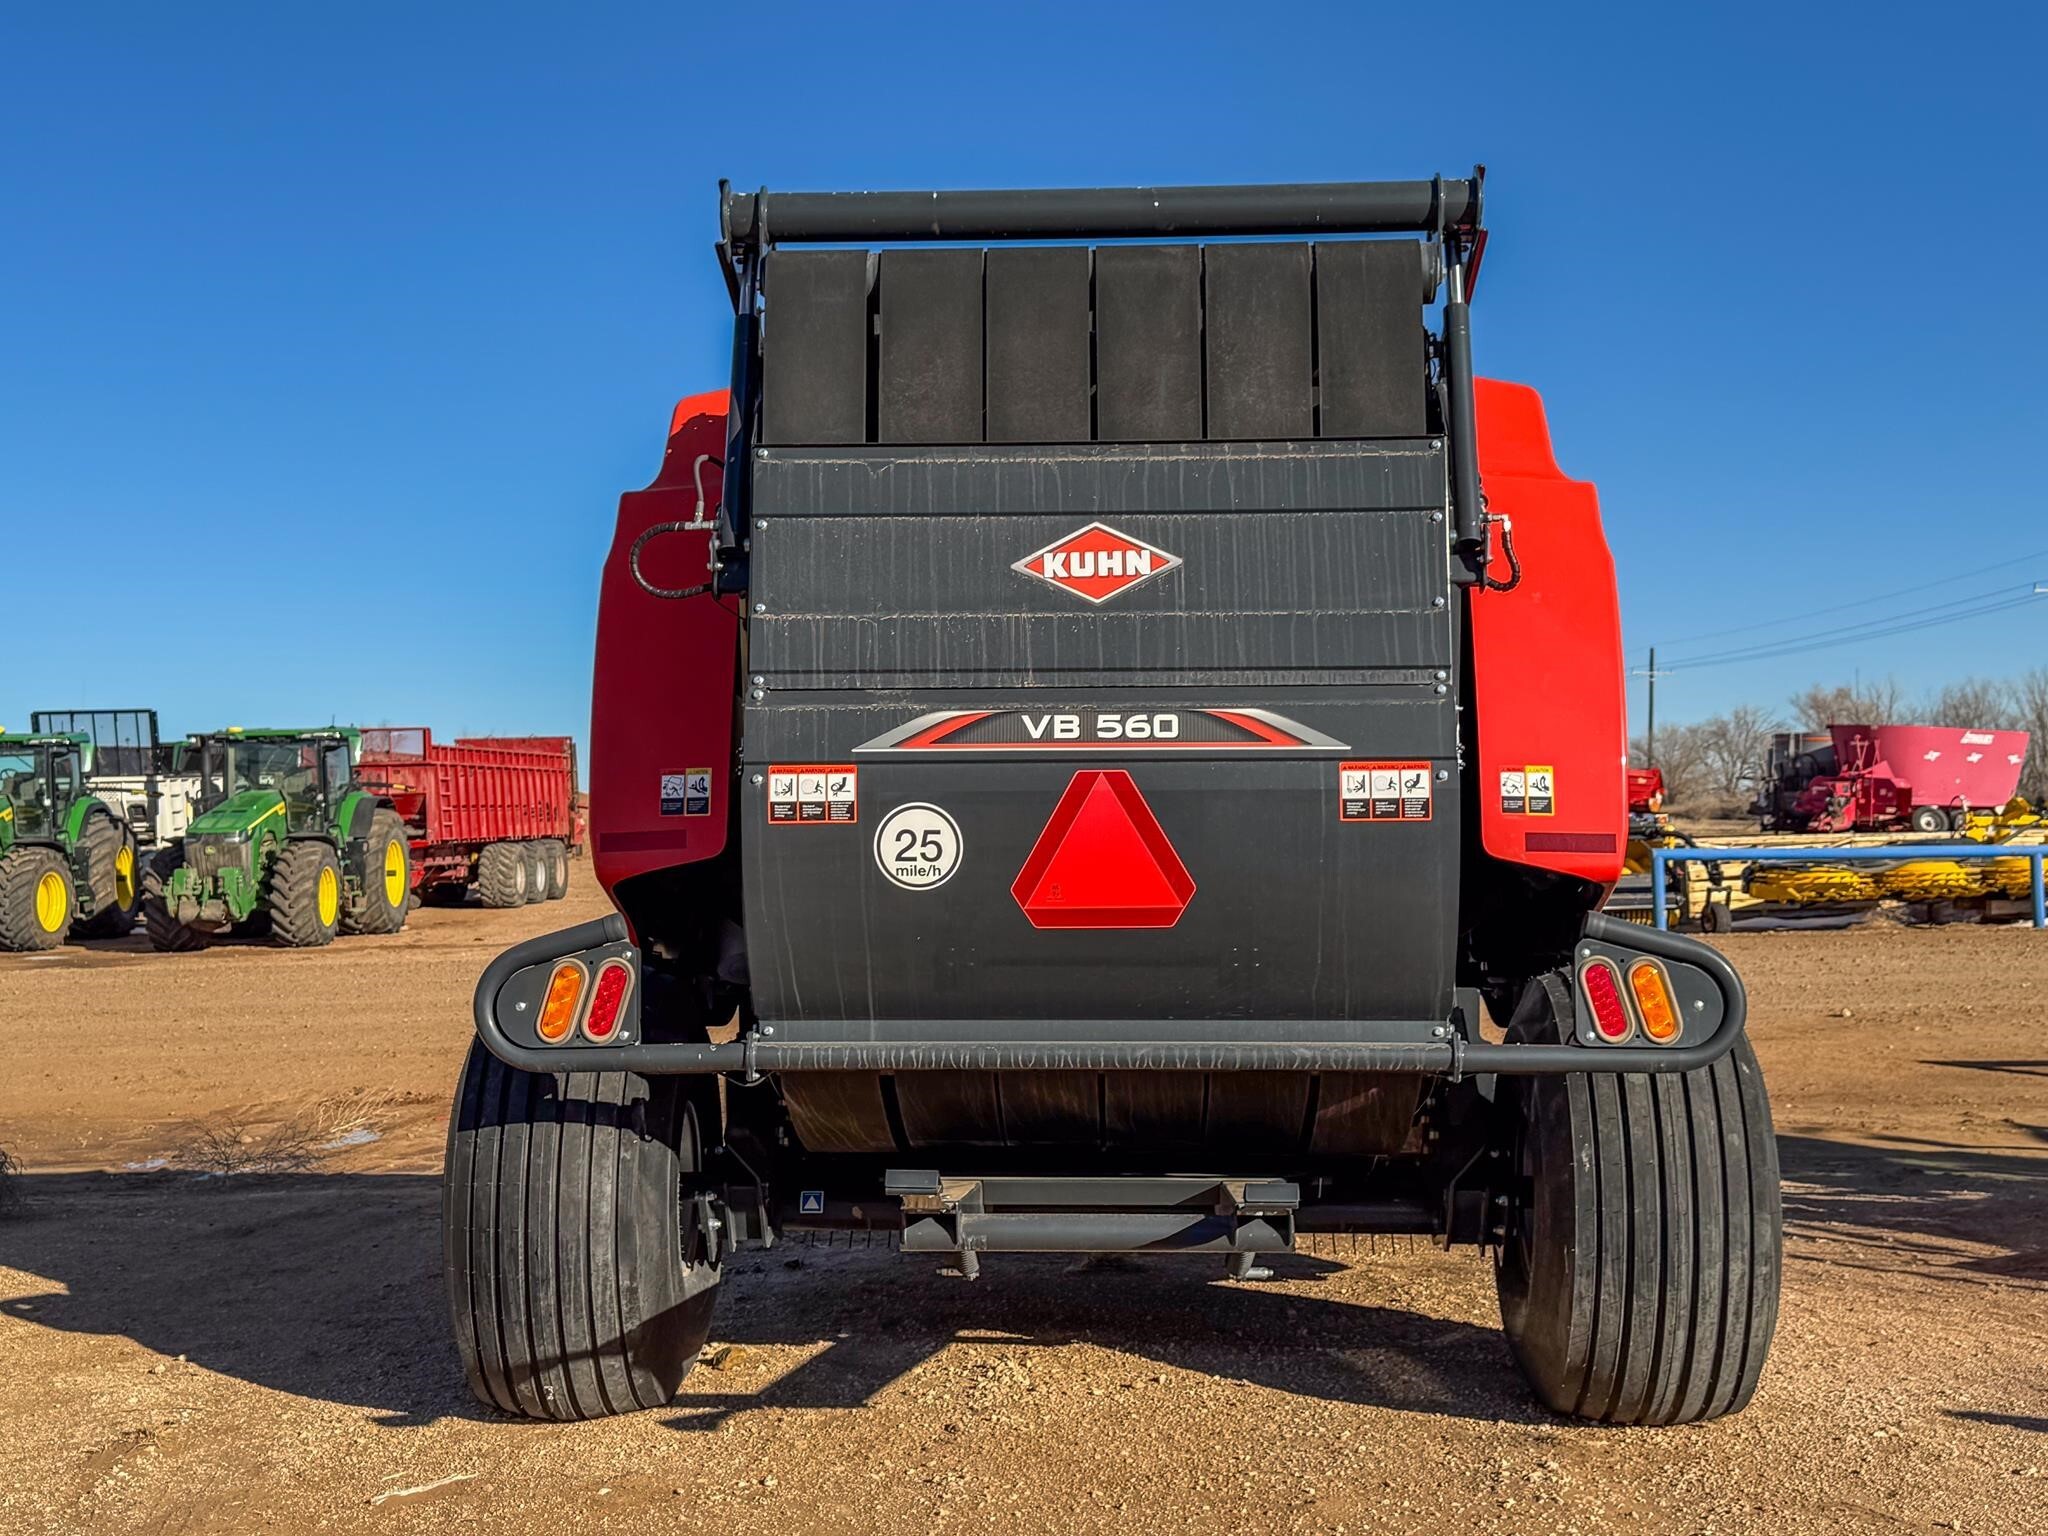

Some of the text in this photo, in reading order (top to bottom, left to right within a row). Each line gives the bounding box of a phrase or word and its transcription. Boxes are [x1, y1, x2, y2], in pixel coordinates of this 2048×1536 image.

[1042, 549, 1151, 578] KUHN
[1021, 713, 1180, 739] VB 560
[894, 828, 943, 863] 25
[895, 864, 942, 877] mile/h
